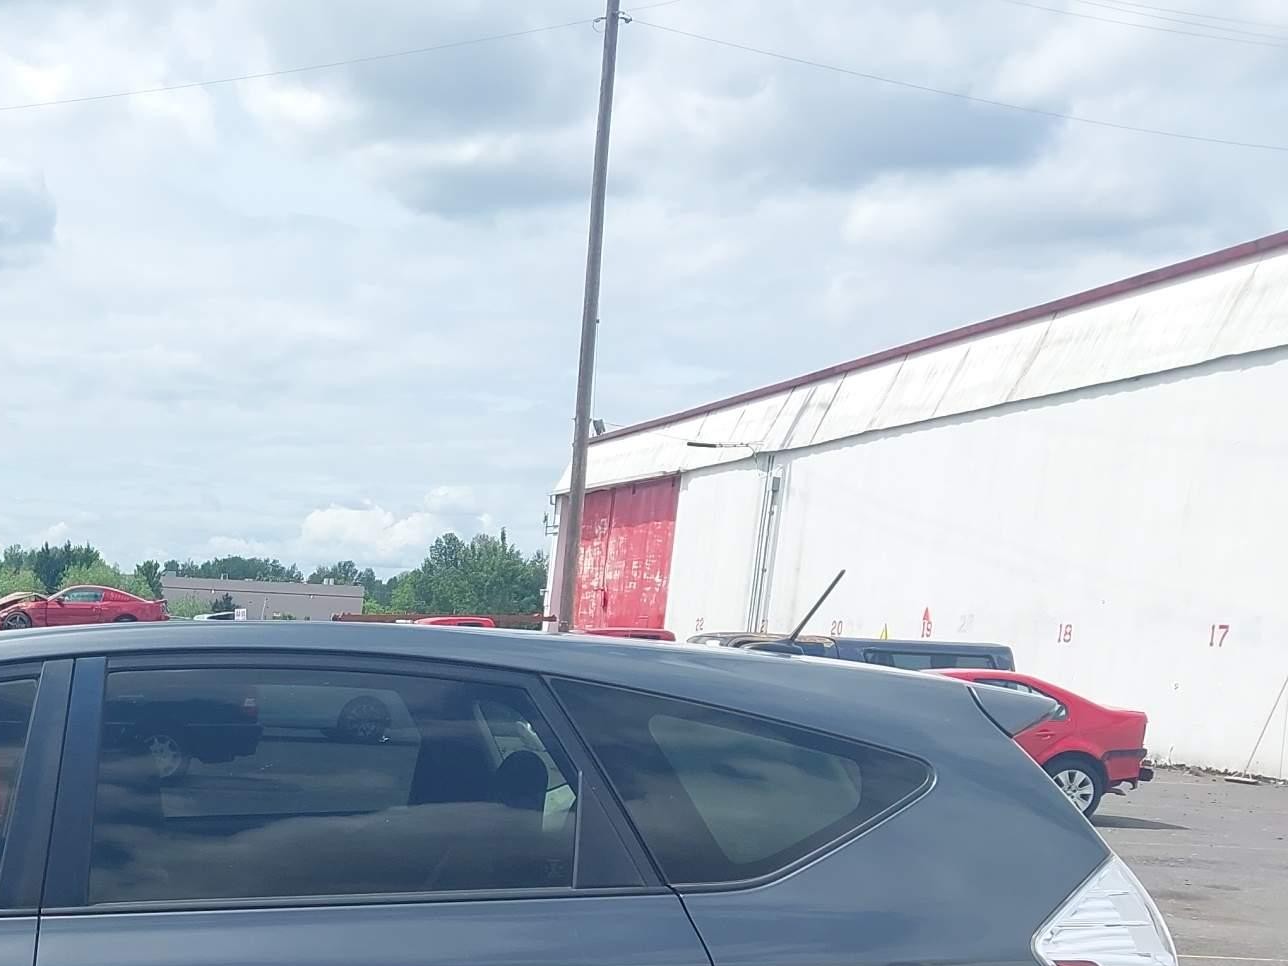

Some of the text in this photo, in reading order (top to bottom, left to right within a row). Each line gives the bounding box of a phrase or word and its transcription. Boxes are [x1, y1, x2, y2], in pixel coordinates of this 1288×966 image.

[695, 617, 704, 631] 22
[831, 620, 843, 635] 20
[921, 621, 932, 638] 19
[1057, 623, 1073, 643] 18
[1209, 624, 1230, 647] 17
